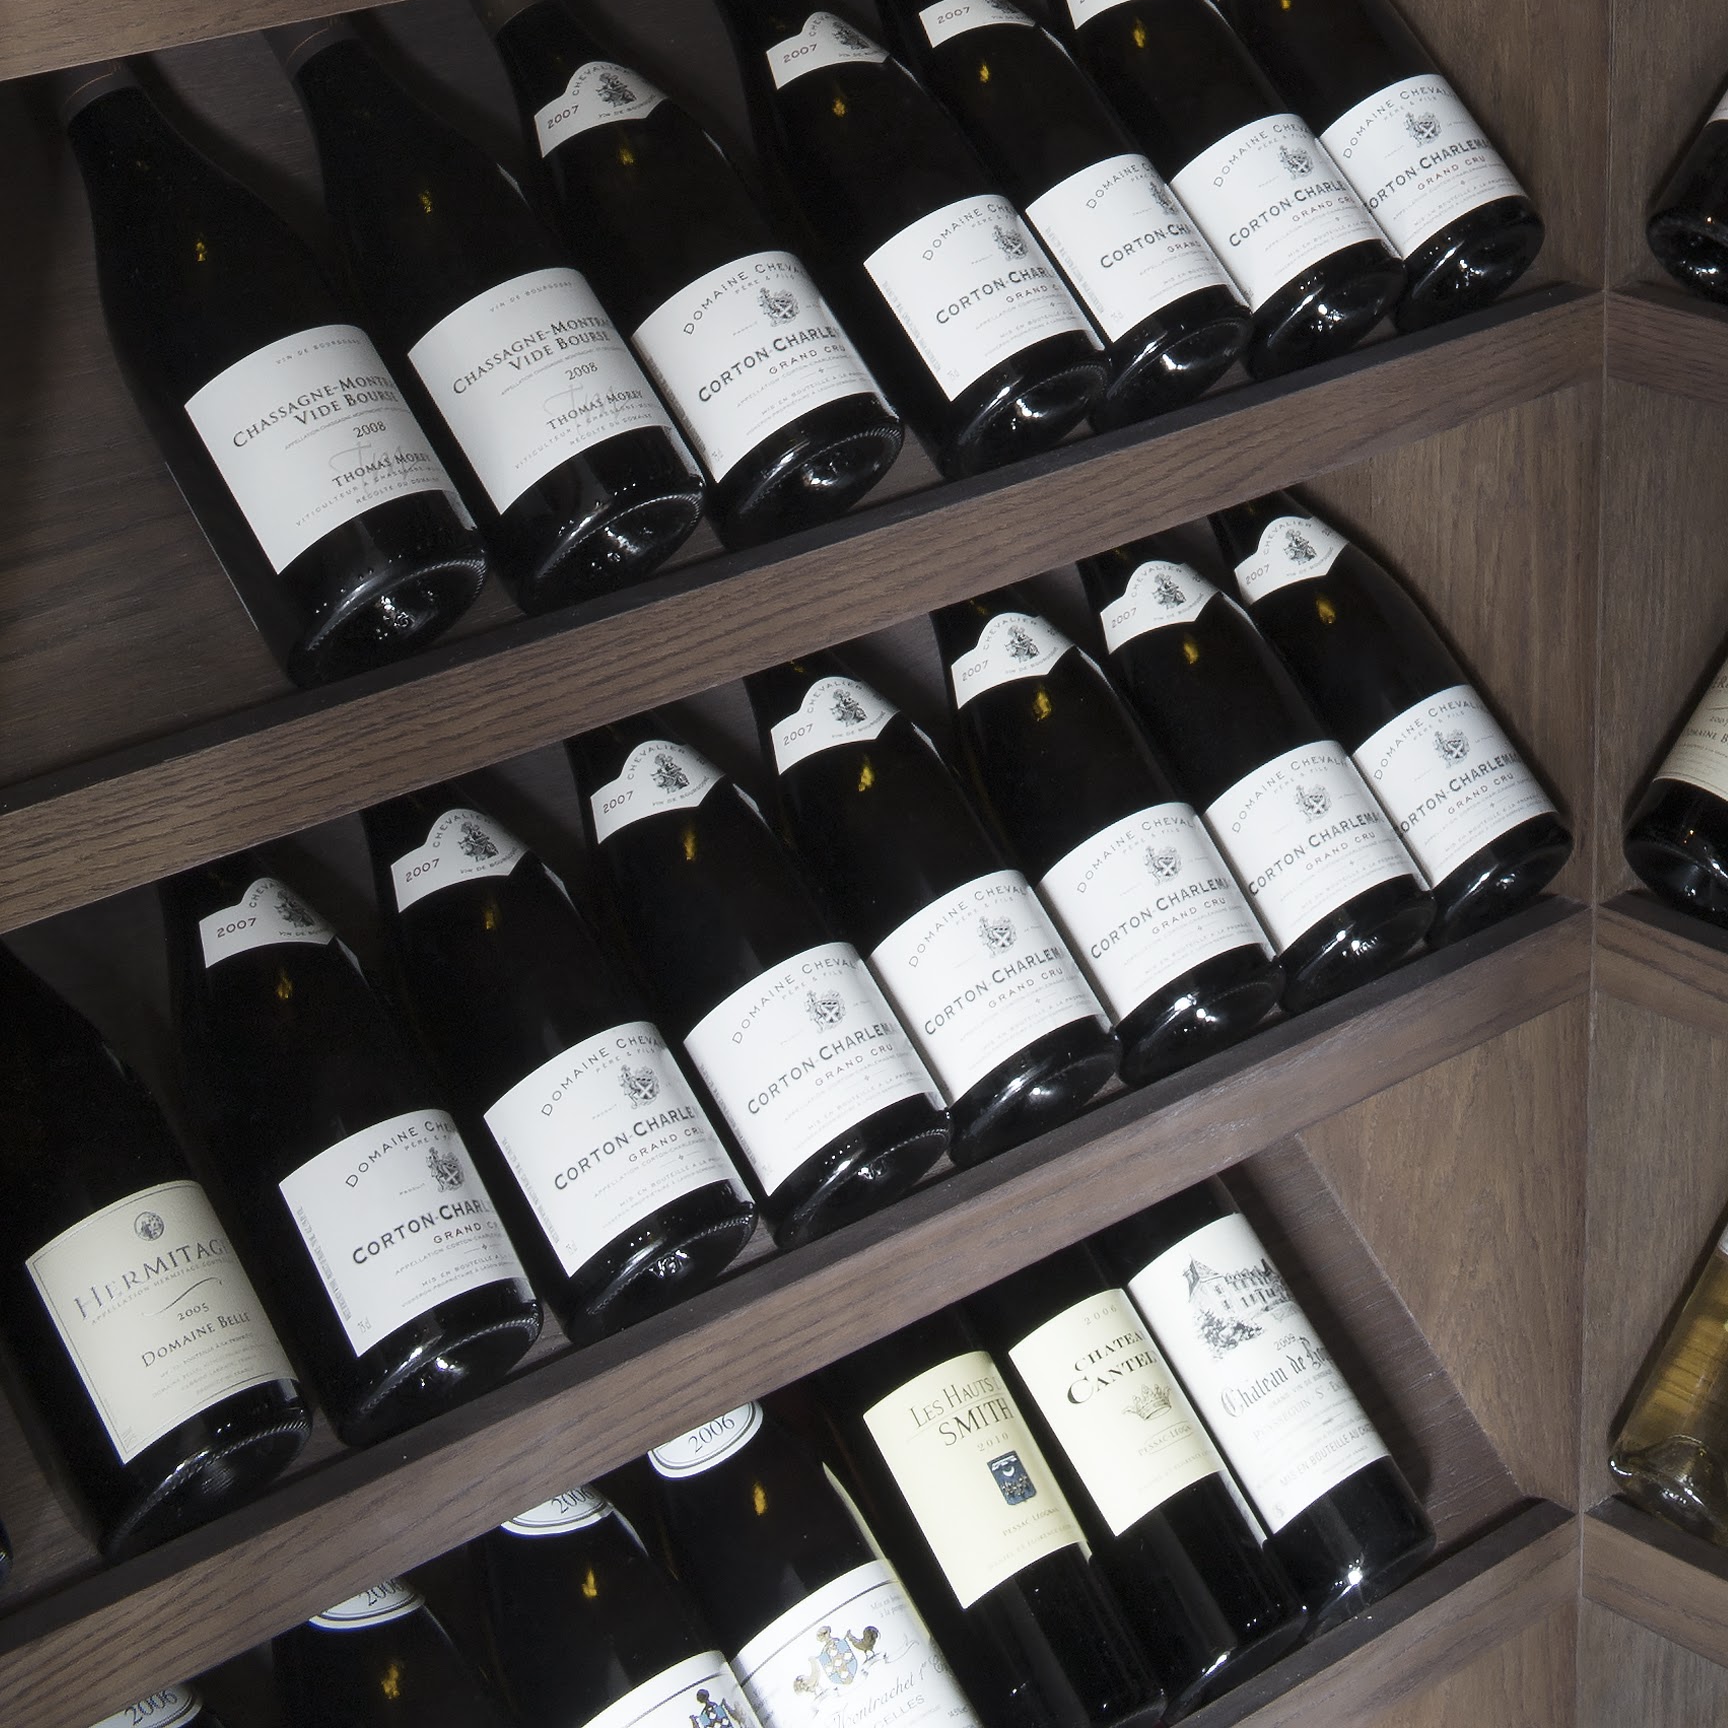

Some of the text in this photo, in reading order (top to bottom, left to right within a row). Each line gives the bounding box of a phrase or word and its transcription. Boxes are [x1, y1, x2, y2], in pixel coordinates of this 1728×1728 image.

[782, 44, 819, 64] 2007
[545, 104, 580, 130] 2007
[564, 361, 599, 382] 2008
[352, 419, 387, 440] 2008
[331, 458, 391, 488] THOMAS
[405, 858, 440, 882] 2007
[1203, 896, 1228, 910] CRU
[216, 917, 258, 939] 2007
[1041, 968, 1064, 981] CRU
[814, 1058, 866, 1087] GRAND
[345, 1128, 420, 1190] DOMAINE
[628, 1136, 680, 1164] GRAND
[177, 1301, 210, 1322] 2005
[141, 1322, 215, 1369] DOMAINE
[909, 1402, 945, 1430] LES
[688, 1414, 736, 1457] 2006
[976, 1432, 1010, 1453] 2010
